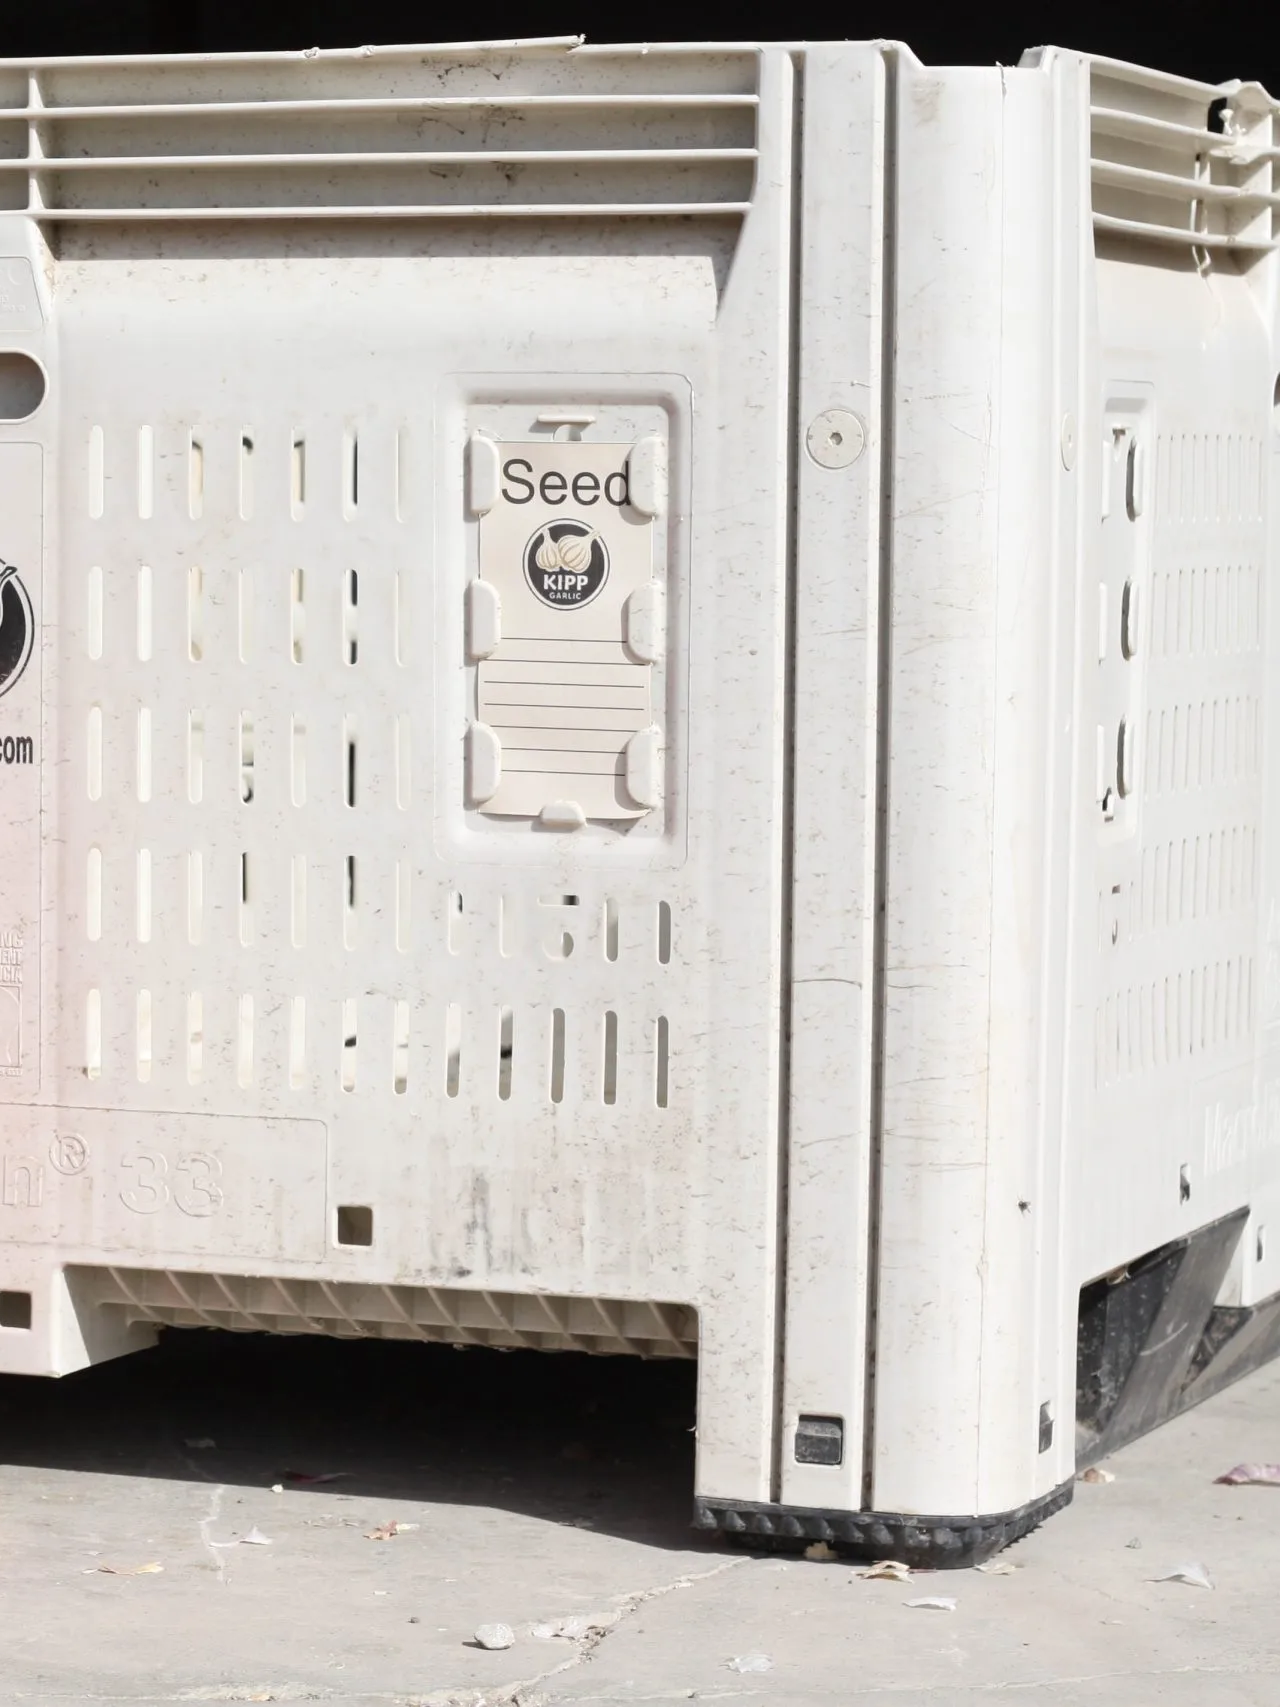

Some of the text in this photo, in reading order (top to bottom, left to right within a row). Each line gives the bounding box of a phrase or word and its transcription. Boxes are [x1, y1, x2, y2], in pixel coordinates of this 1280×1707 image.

[502, 458, 633, 506] Seed
[543, 574, 589, 591] KIPP
[549, 592, 582, 600] GARLIC
[119, 1150, 225, 1218] 33
